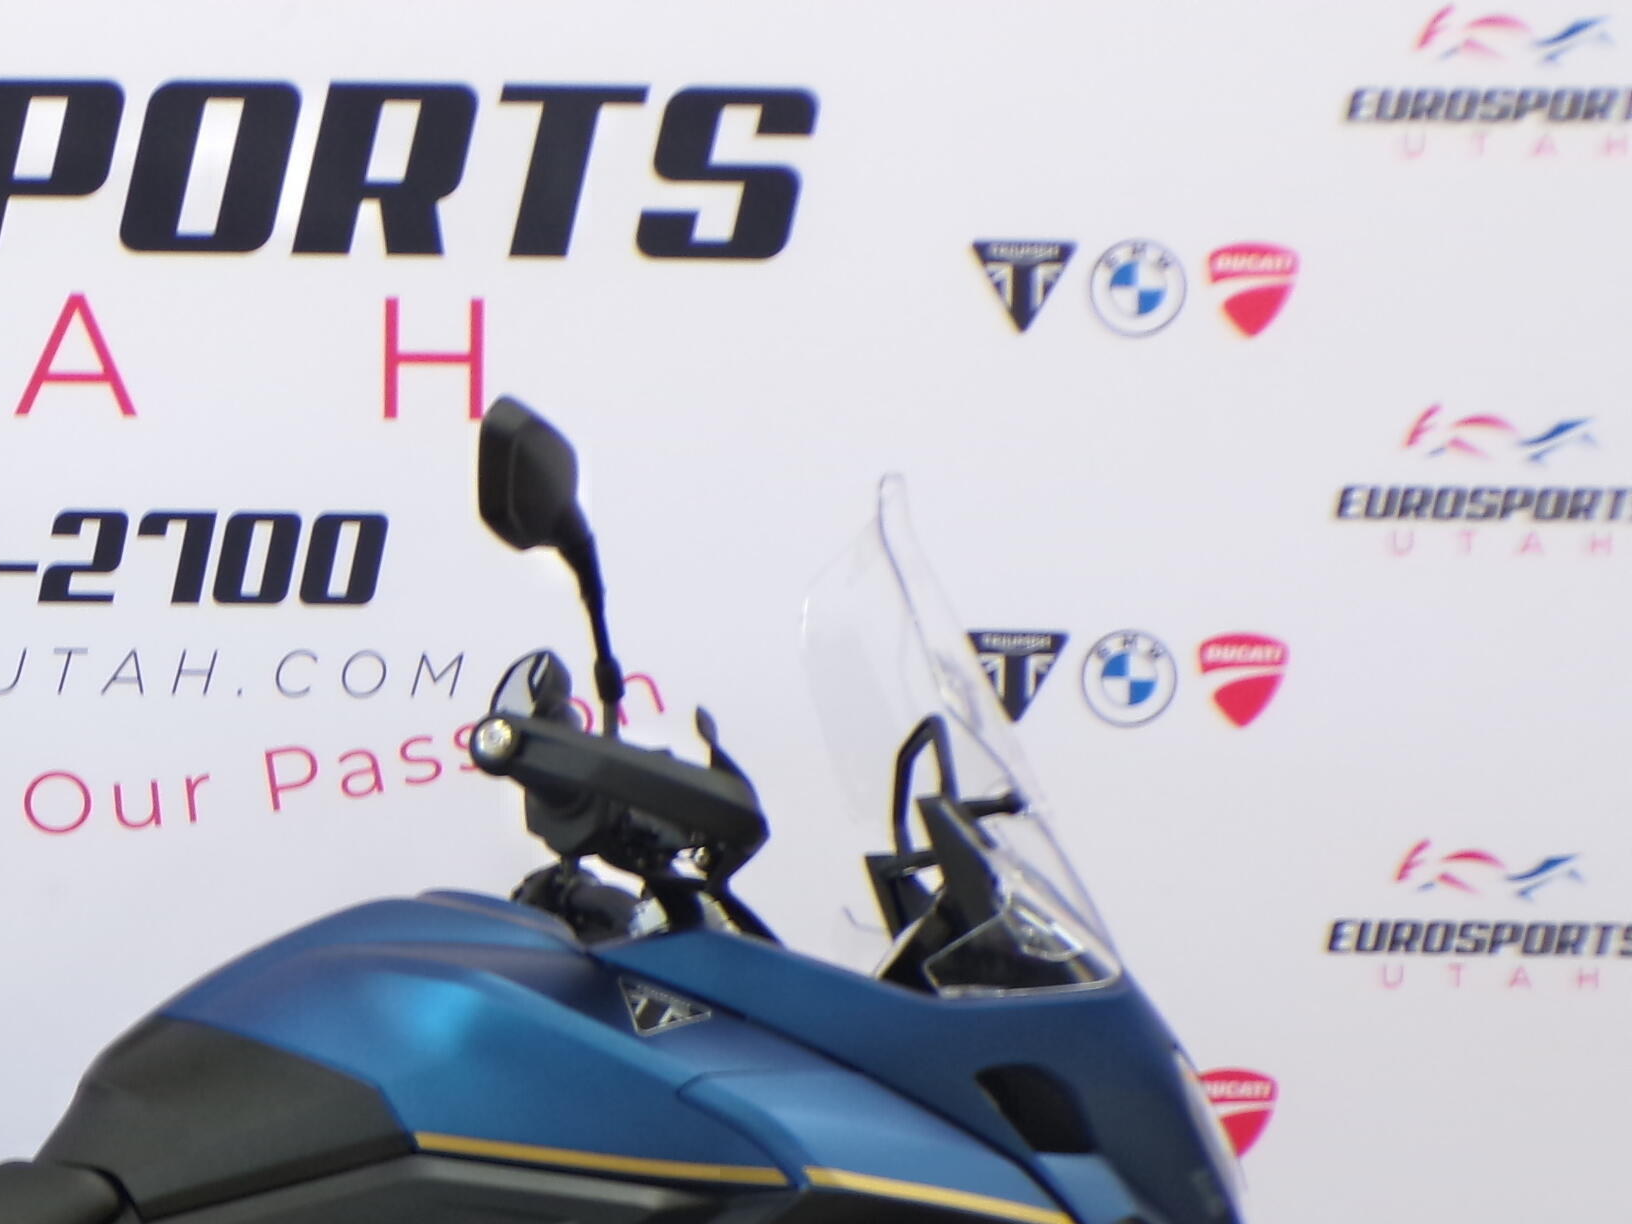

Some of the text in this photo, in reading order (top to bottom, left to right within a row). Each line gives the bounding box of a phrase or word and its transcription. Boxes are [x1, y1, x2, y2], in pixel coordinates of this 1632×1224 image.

[1217, 254, 1293, 272] DUCATI
[1206, 643, 1284, 662] DUCATI
[22, 769, 211, 836] Our
[264, 671, 666, 813] Passn
[1204, 1080, 1272, 1098] UCATI
